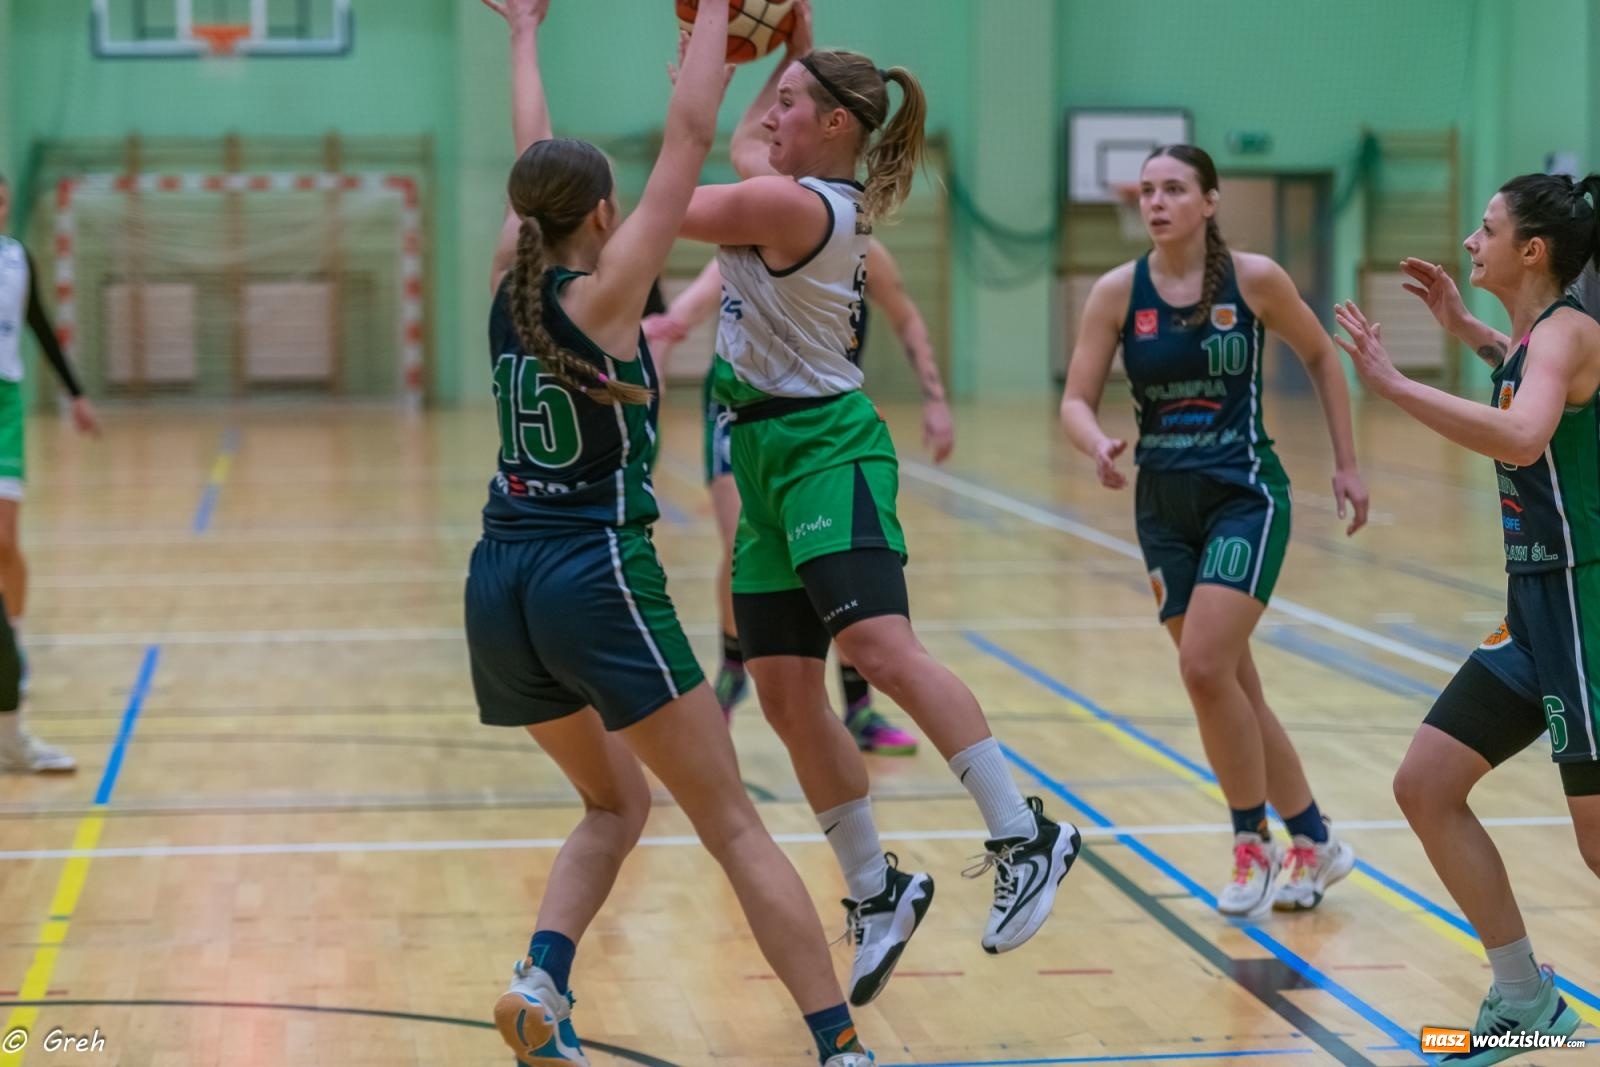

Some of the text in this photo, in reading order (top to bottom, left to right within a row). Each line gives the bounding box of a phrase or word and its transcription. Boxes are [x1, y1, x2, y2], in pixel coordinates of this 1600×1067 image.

[1201, 332, 1248, 376] 10
[493, 354, 582, 468] 15
[1203, 537, 1251, 582] 10
[1543, 695, 1569, 754] 6
